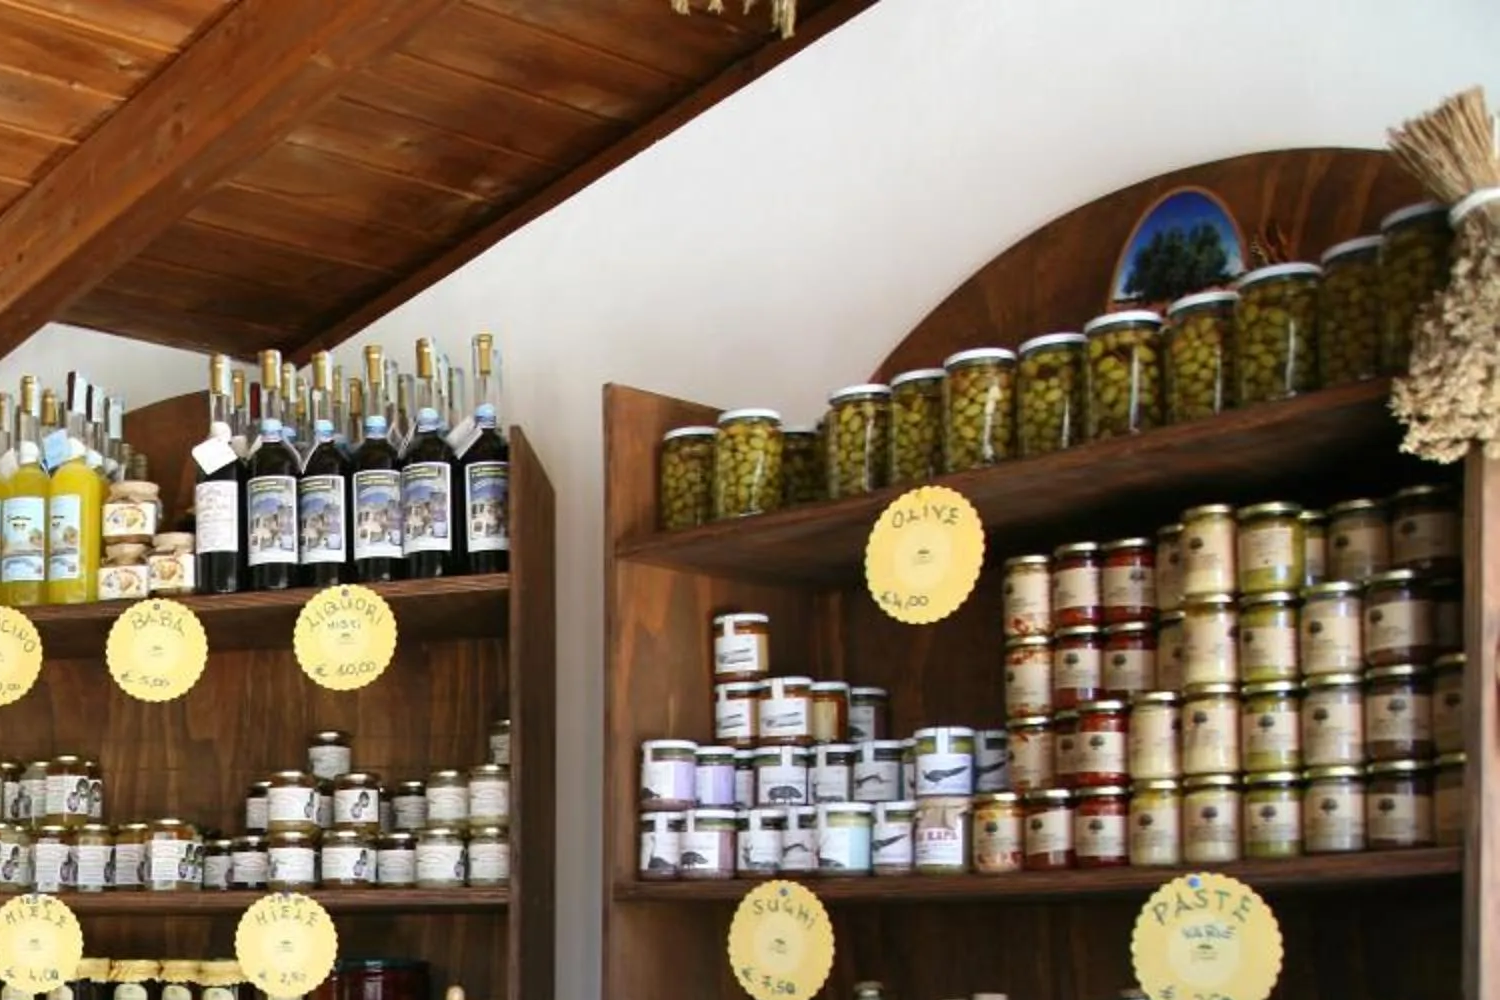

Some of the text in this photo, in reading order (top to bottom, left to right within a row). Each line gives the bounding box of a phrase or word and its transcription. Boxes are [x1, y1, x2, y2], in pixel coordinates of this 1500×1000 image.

[892, 503, 960, 529] OLIVE
[306, 598, 385, 631] LIQUORI
[5, 906, 68, 931] MIELE
[254, 905, 320, 928] MIELE
[752, 898, 817, 931] SUGHI
[1153, 889, 1253, 927] PASTE
